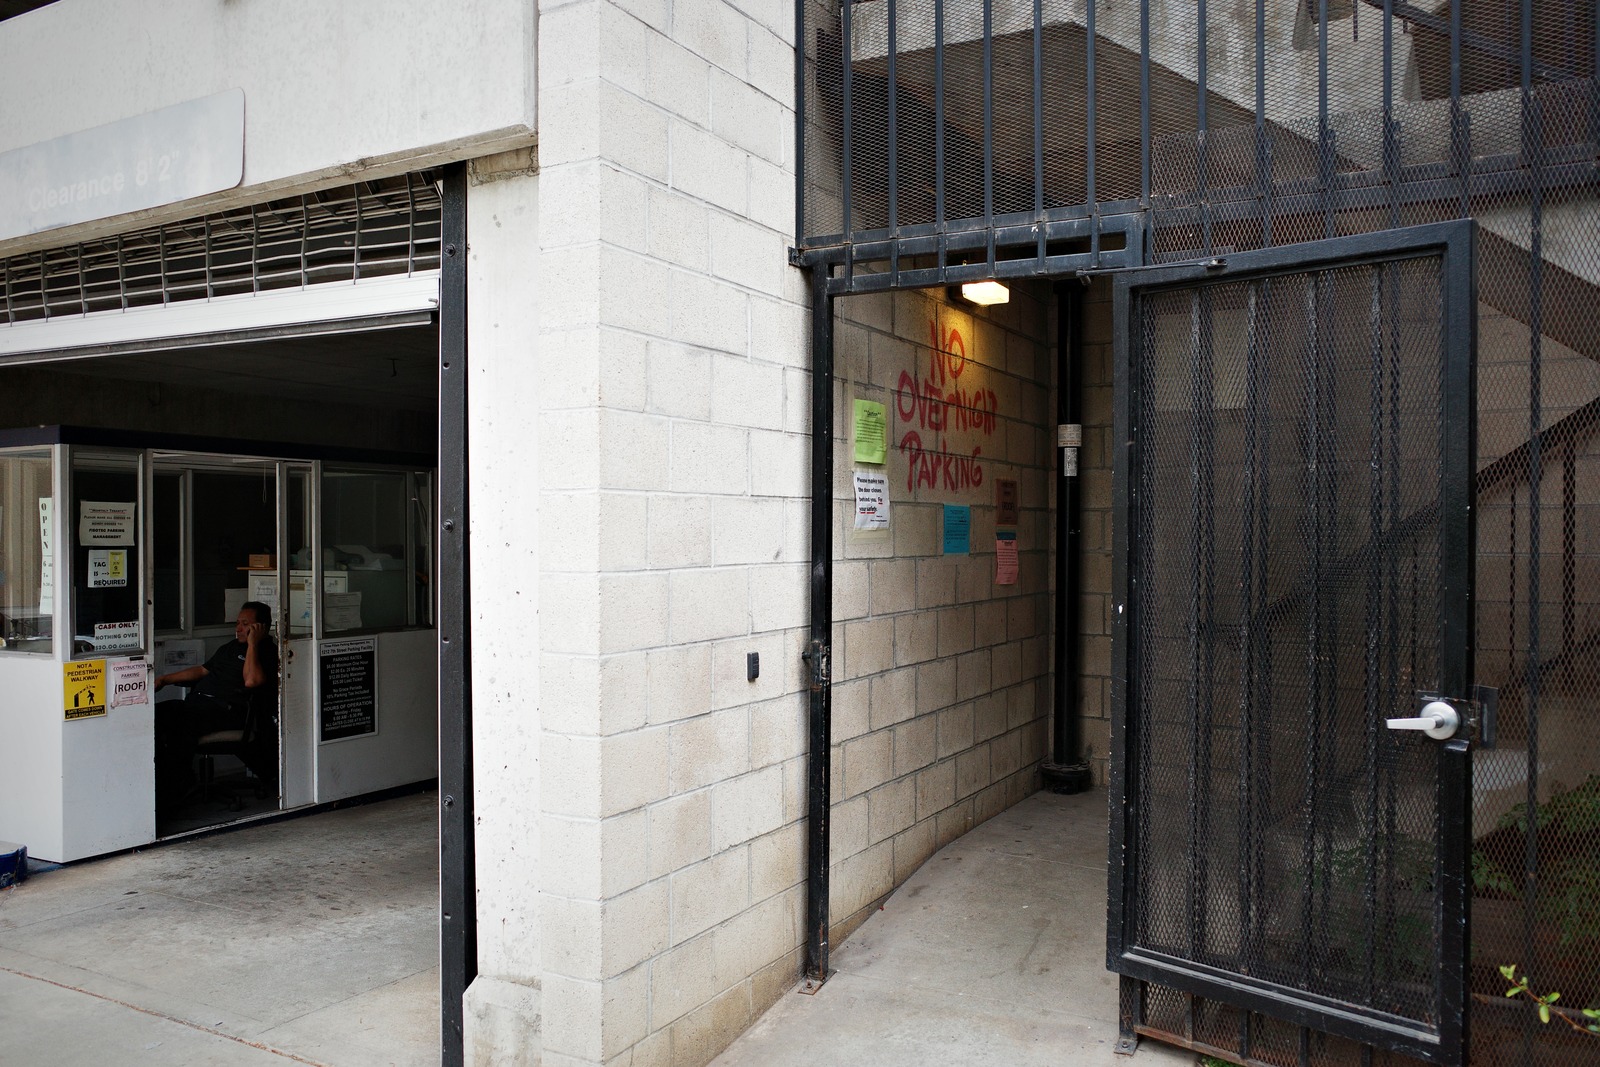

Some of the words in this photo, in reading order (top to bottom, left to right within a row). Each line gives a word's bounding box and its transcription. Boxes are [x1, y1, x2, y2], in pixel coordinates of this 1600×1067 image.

[29, 171, 124, 212] Clearance
[930, 320, 965, 386] NO
[115, 681, 146, 694] (ROOF)
